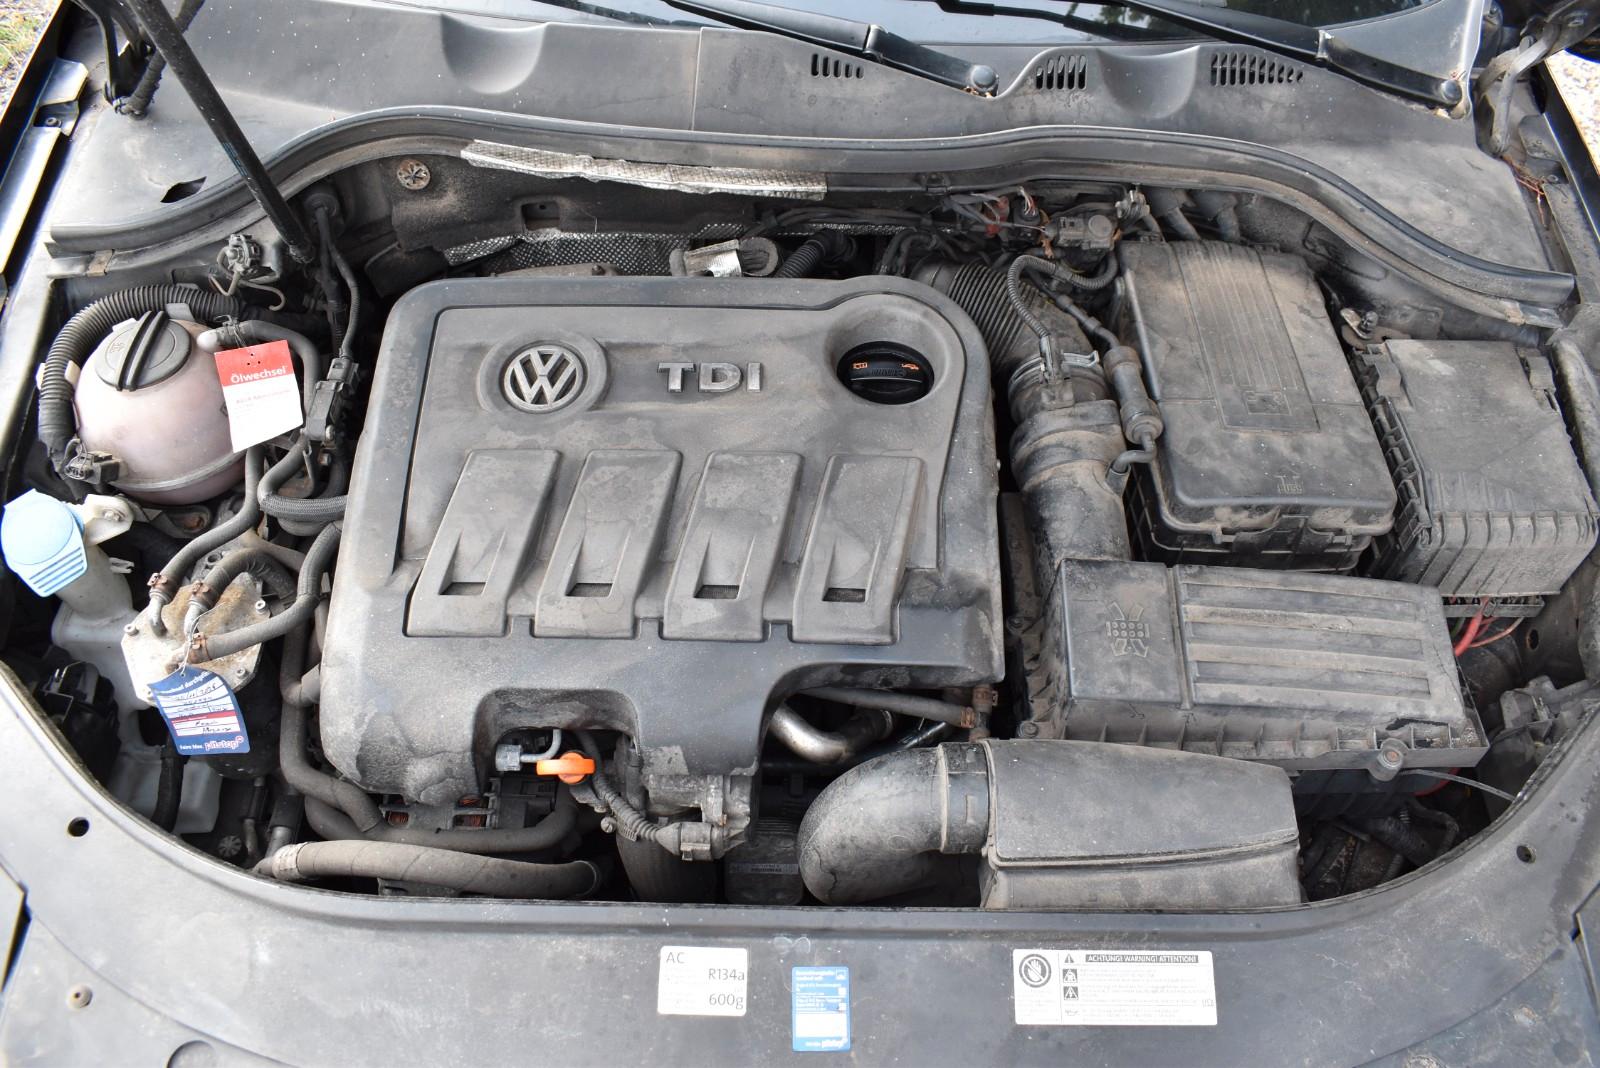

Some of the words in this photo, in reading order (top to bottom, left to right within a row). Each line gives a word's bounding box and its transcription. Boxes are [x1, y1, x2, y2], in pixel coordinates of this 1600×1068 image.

[230, 366, 287, 383] Ölwechsel
[657, 362, 763, 393] TDI
[665, 951, 686, 964] AC
[1088, 954, 1123, 962] ACHTUNG!
[1125, 955, 1158, 963] WARNING!
[1159, 955, 1197, 963] ATTENTION!
[708, 967, 745, 981] R134a
[709, 993, 744, 1010] 600g
